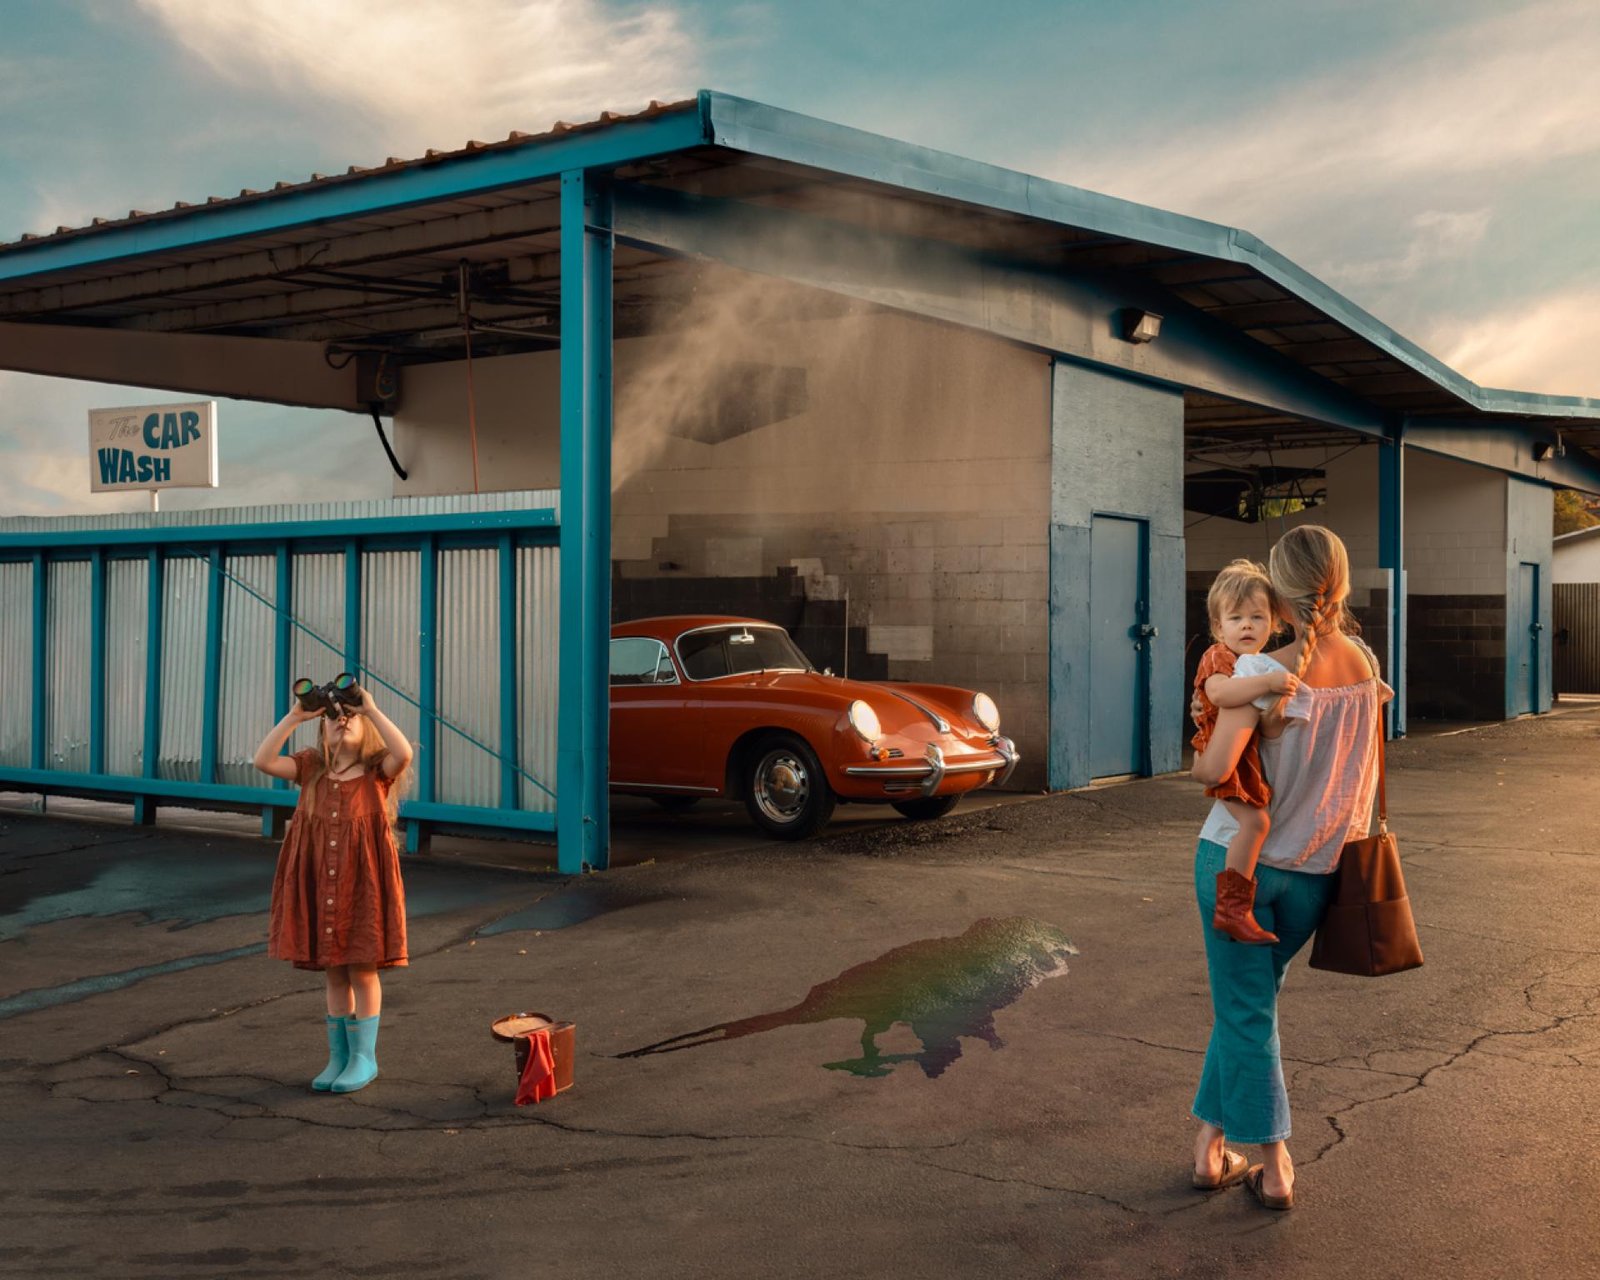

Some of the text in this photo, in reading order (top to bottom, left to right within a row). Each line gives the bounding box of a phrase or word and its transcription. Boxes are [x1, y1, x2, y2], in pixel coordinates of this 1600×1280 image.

[108, 411, 201, 449] The CAR
[98, 447, 171, 484] WASH
